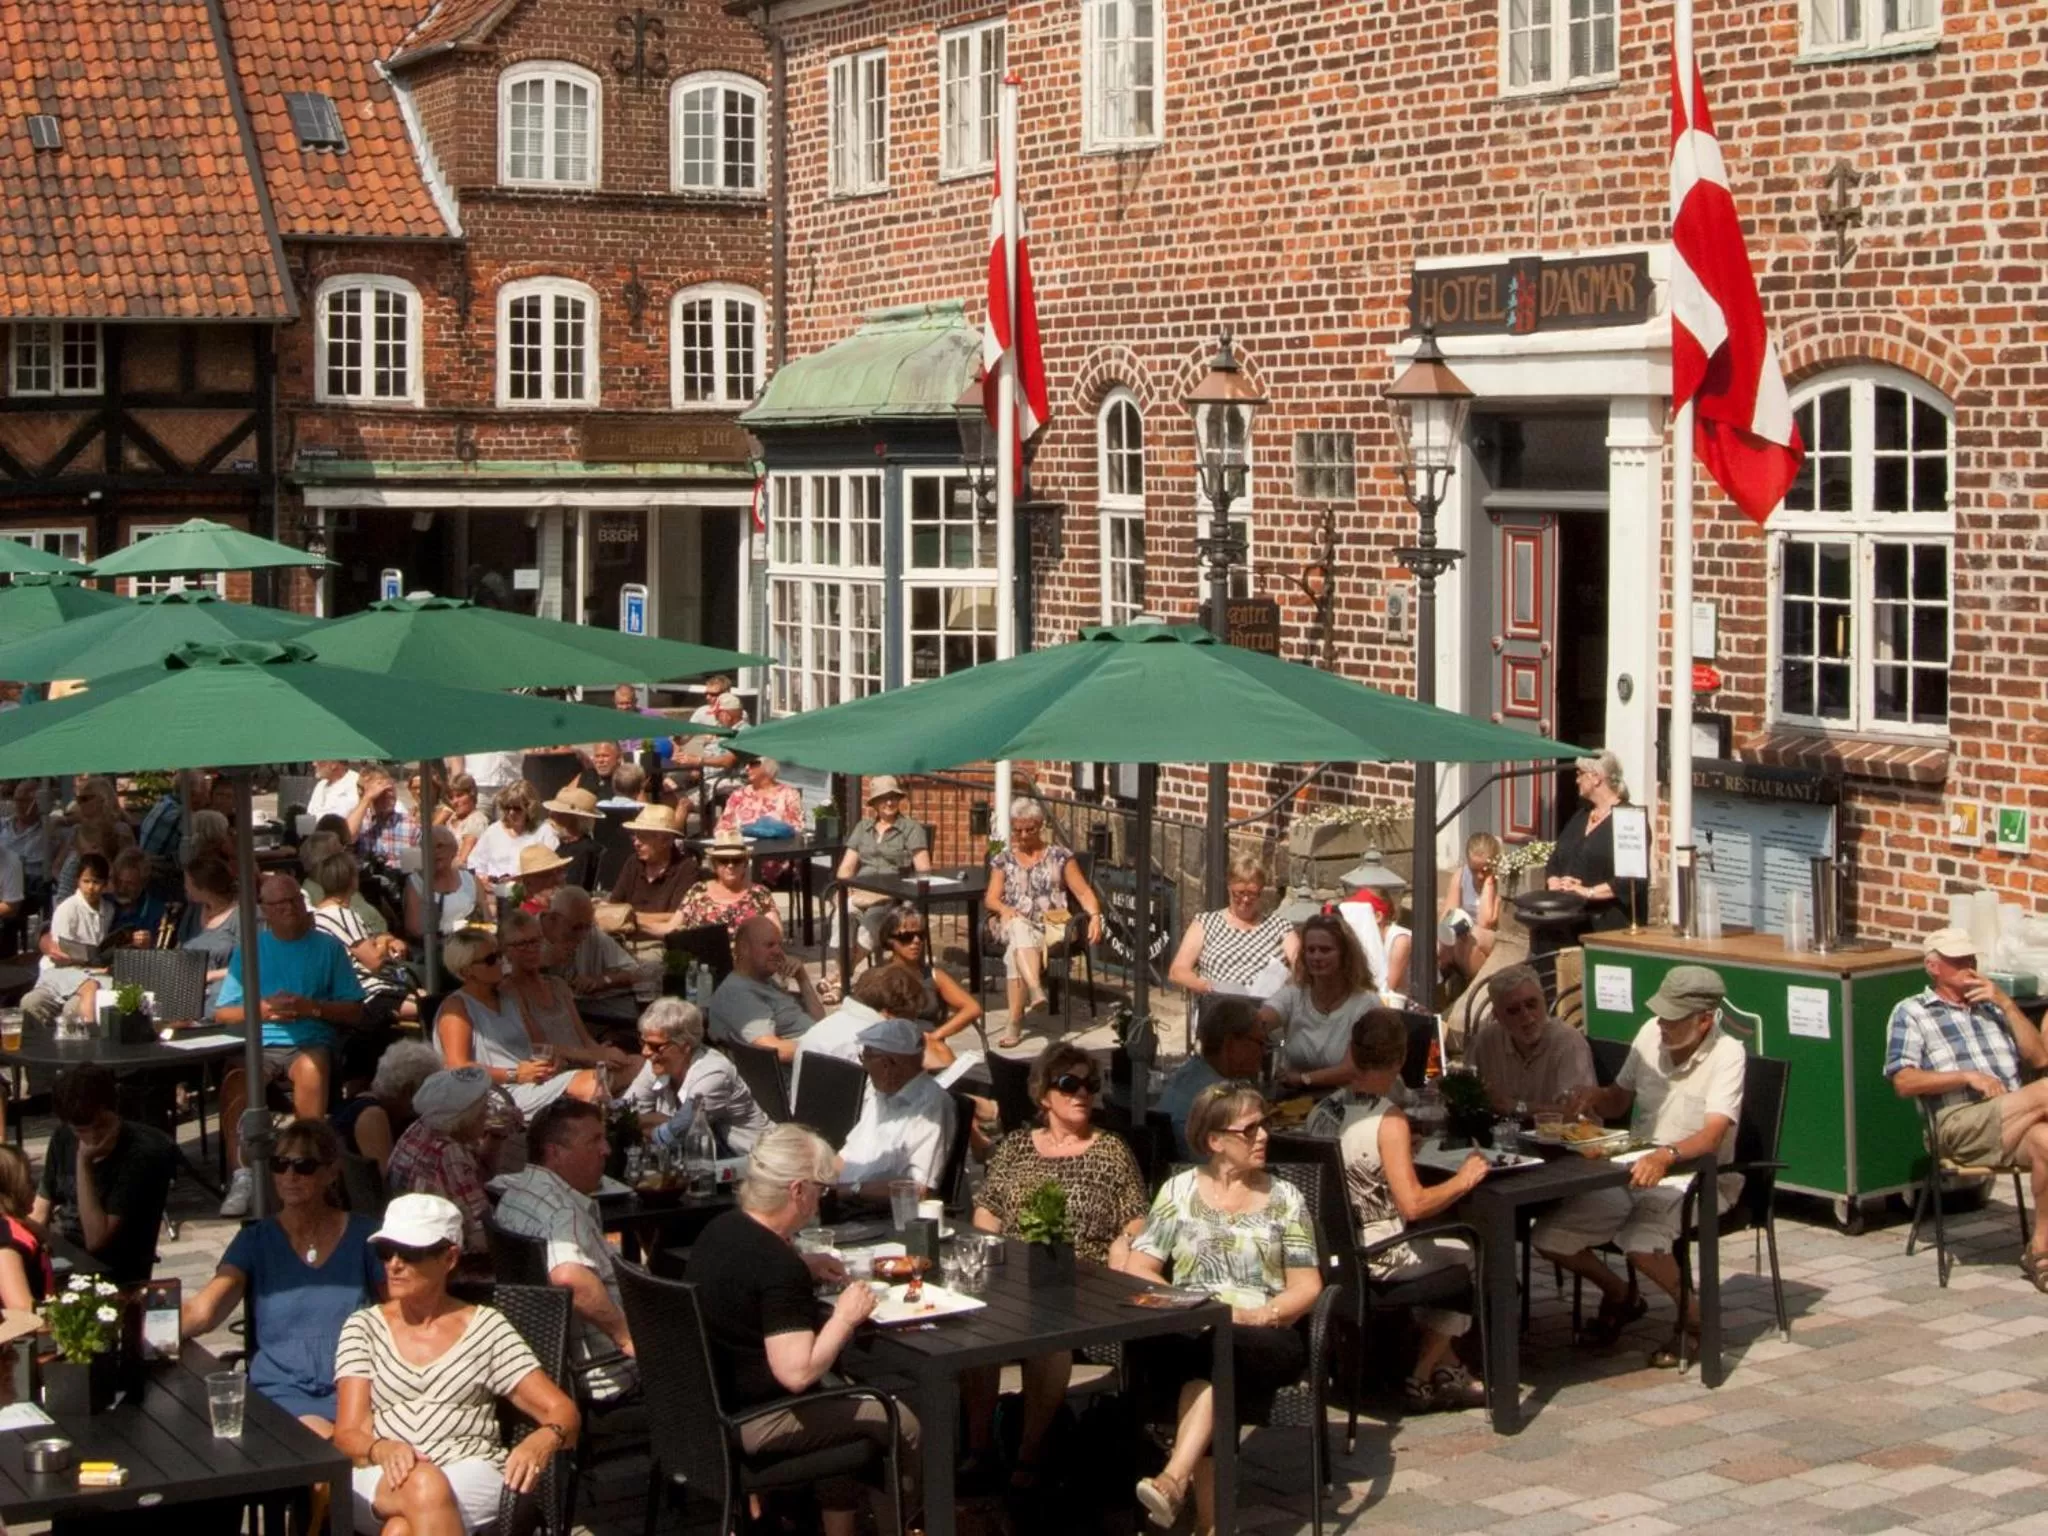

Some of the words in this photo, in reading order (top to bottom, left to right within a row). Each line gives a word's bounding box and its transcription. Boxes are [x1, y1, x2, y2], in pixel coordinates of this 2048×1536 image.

[1419, 273, 1505, 323] HOTEL
[1540, 263, 1636, 317] DAGMAR
[1725, 775, 1810, 799] RESTAURANT
